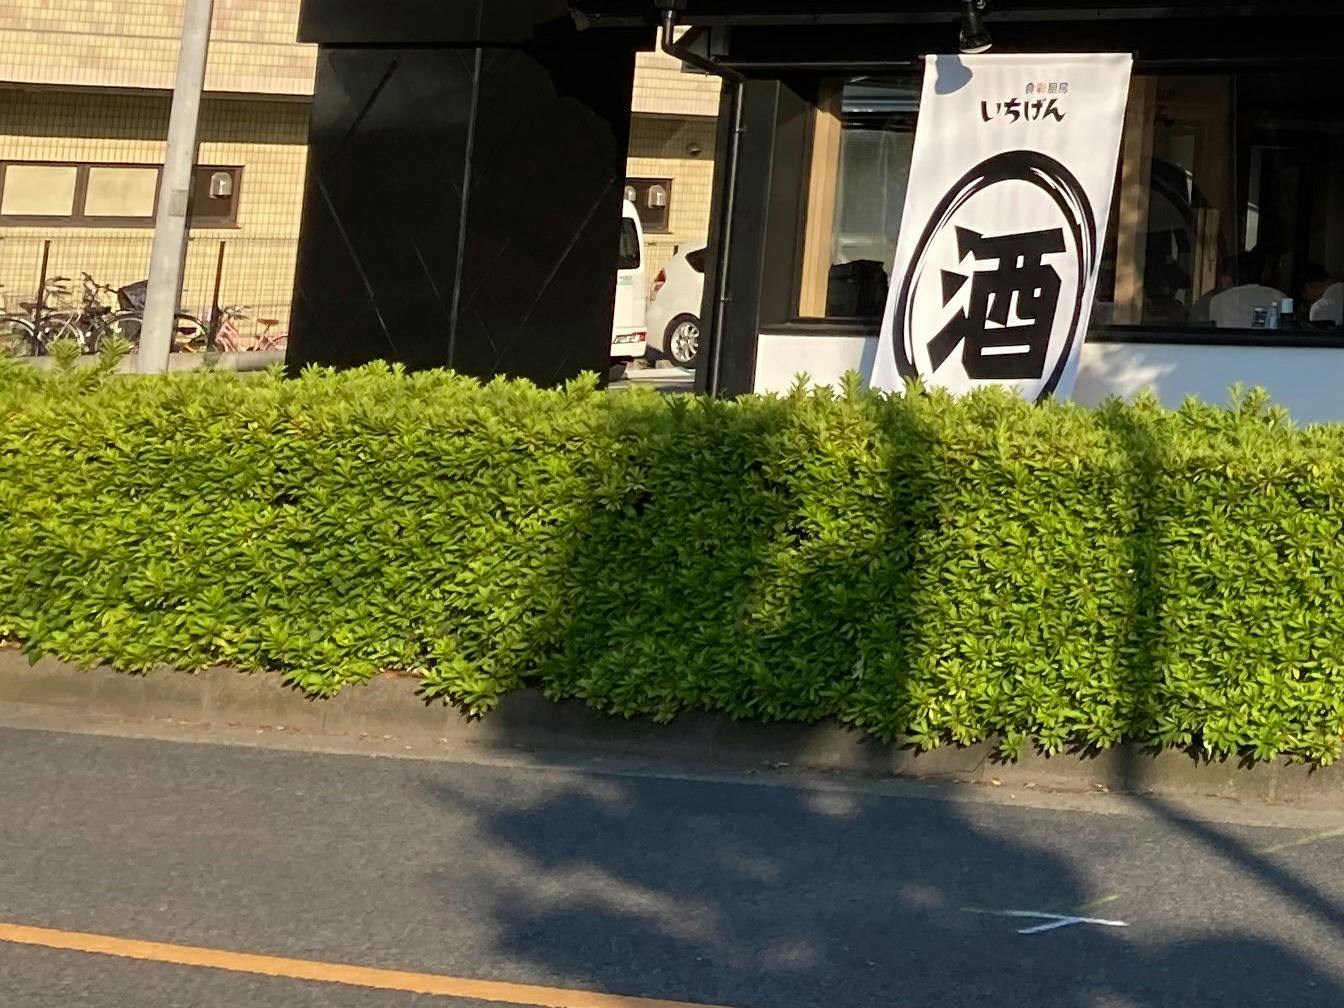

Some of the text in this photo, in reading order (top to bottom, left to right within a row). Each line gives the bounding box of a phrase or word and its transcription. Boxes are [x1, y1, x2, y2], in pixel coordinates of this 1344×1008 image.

[981, 97, 1066, 124] いちげん
[926, 225, 1067, 380] 酒
